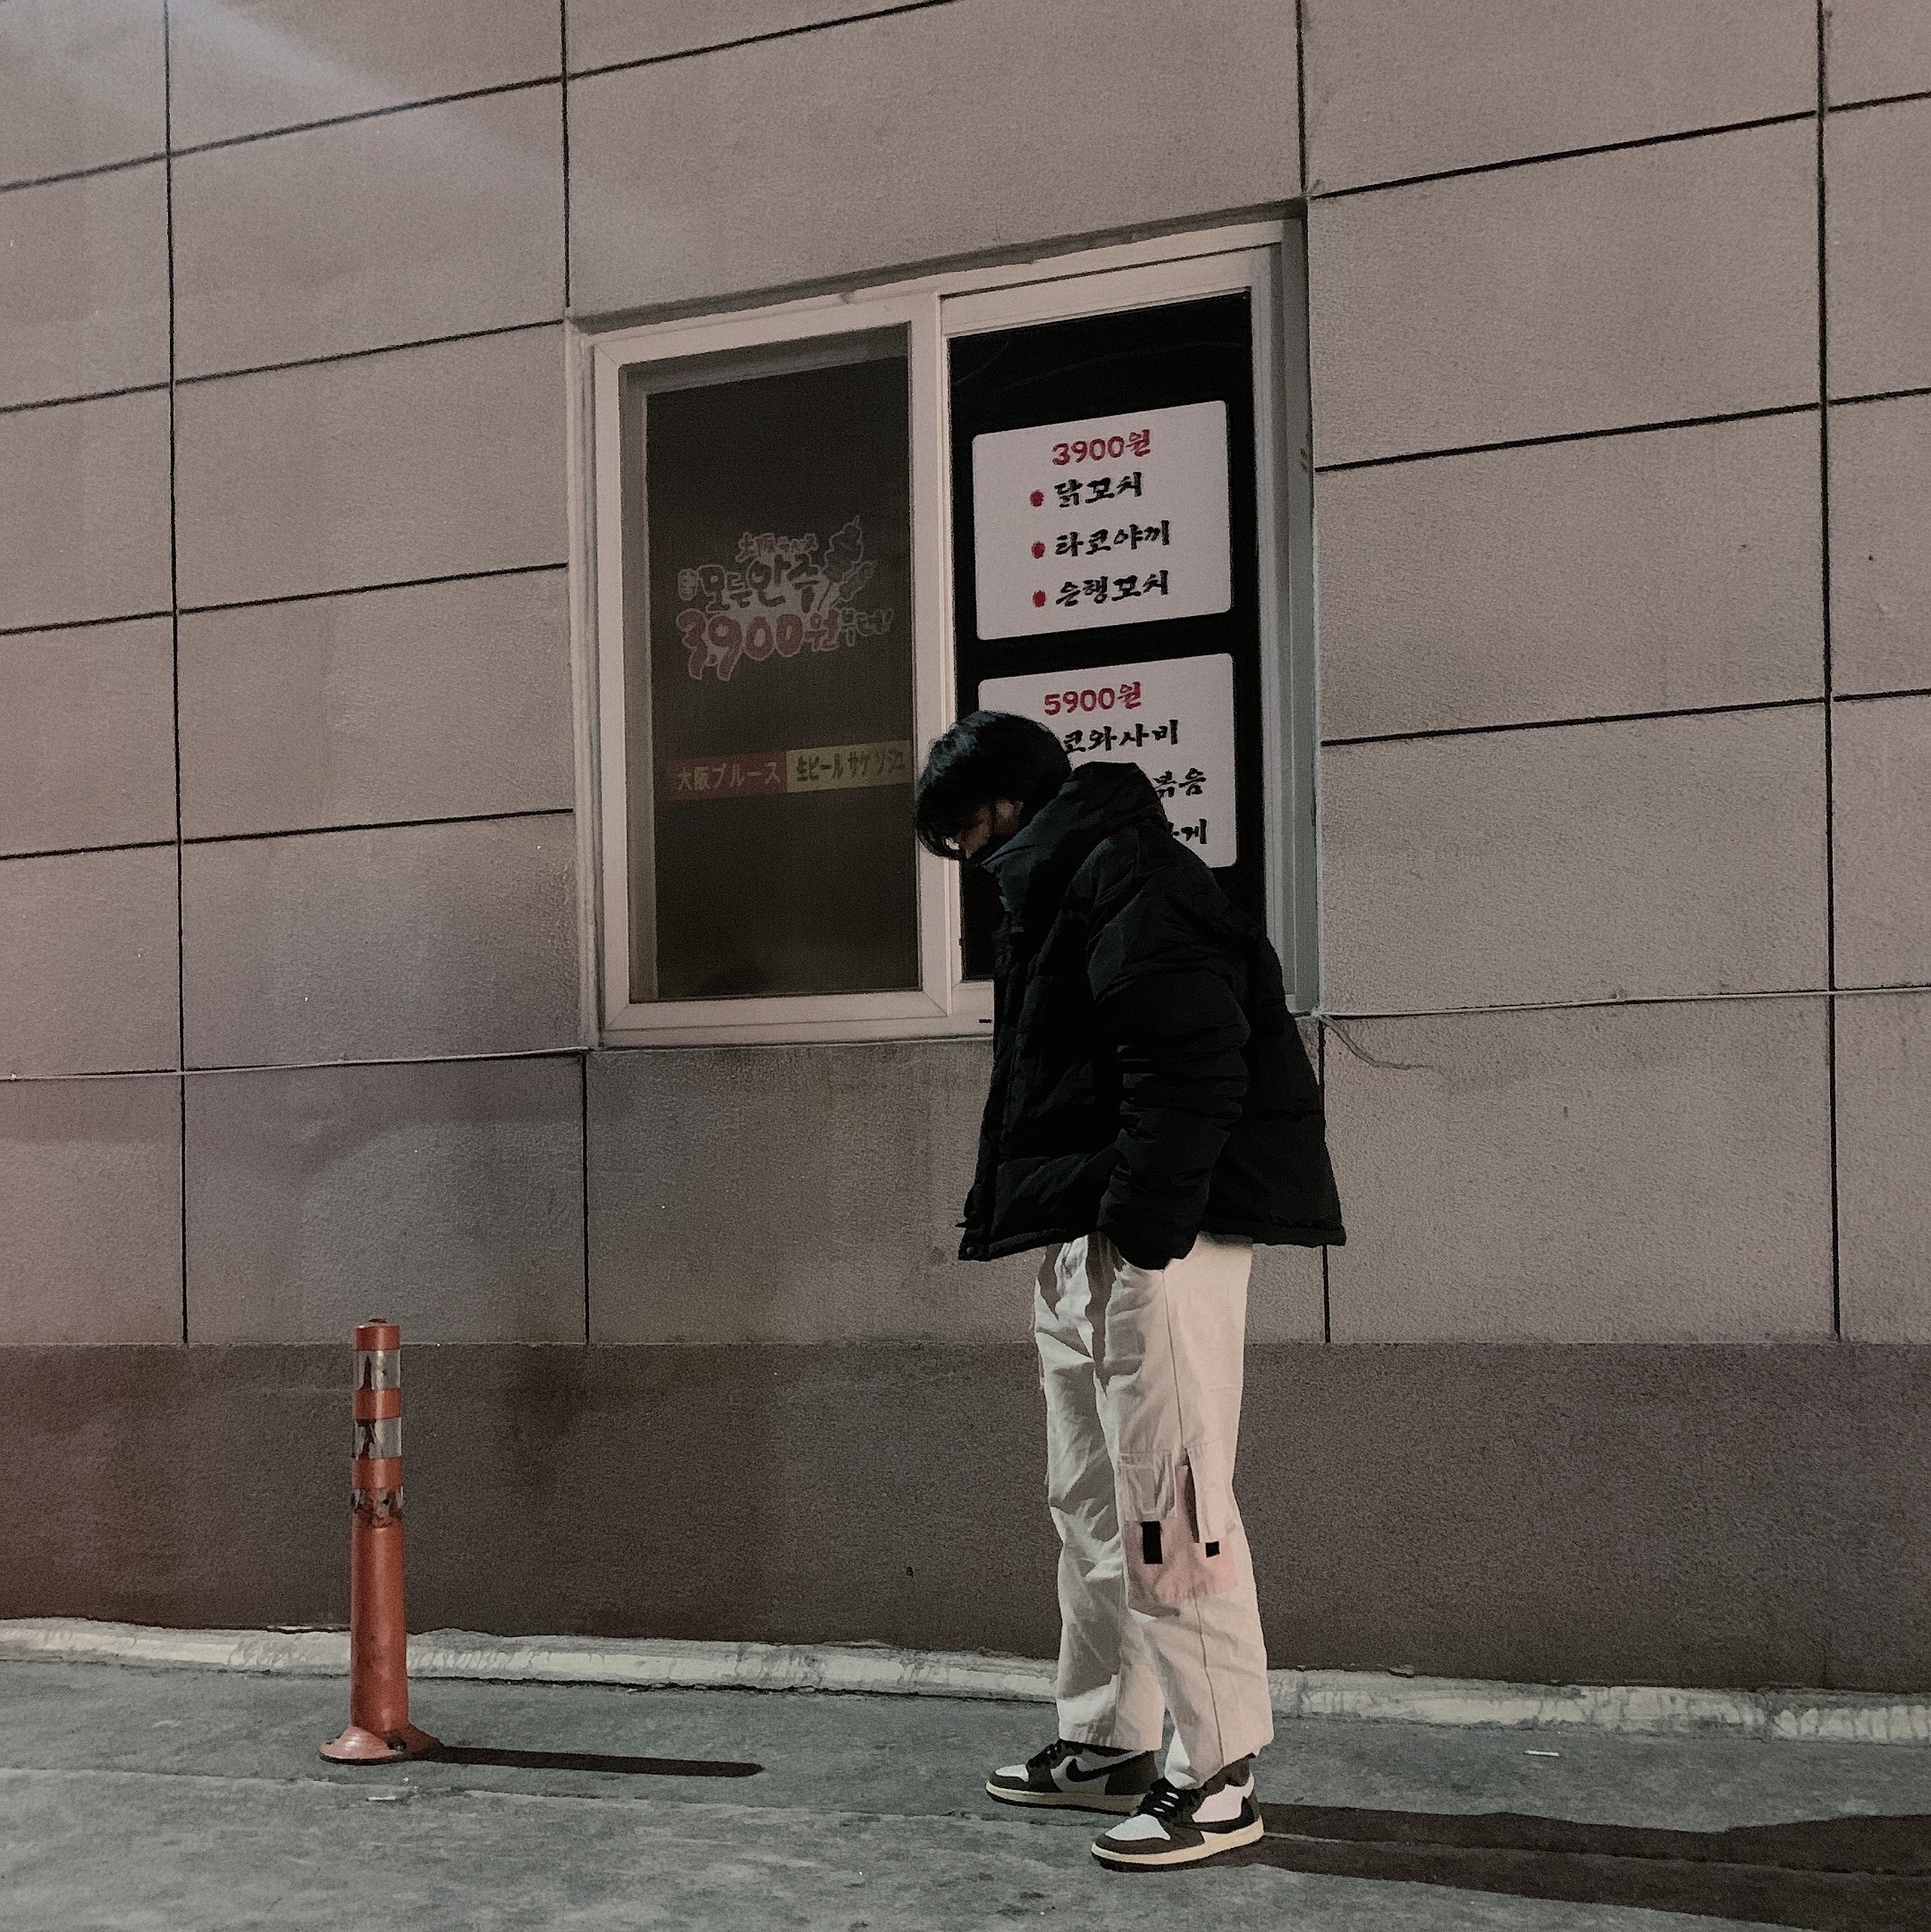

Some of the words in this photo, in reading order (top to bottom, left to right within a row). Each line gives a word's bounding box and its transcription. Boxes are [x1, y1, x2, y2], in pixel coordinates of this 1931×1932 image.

[1052, 429, 1151, 466] 3900원
[1055, 471, 1143, 508] 닭꼬치
[1055, 519, 1170, 557] 타코야끼
[1055, 569, 1169, 607] 은행꼬치
[1044, 681, 1143, 716] 5900원
[1063, 719, 1179, 753] 코와사비
